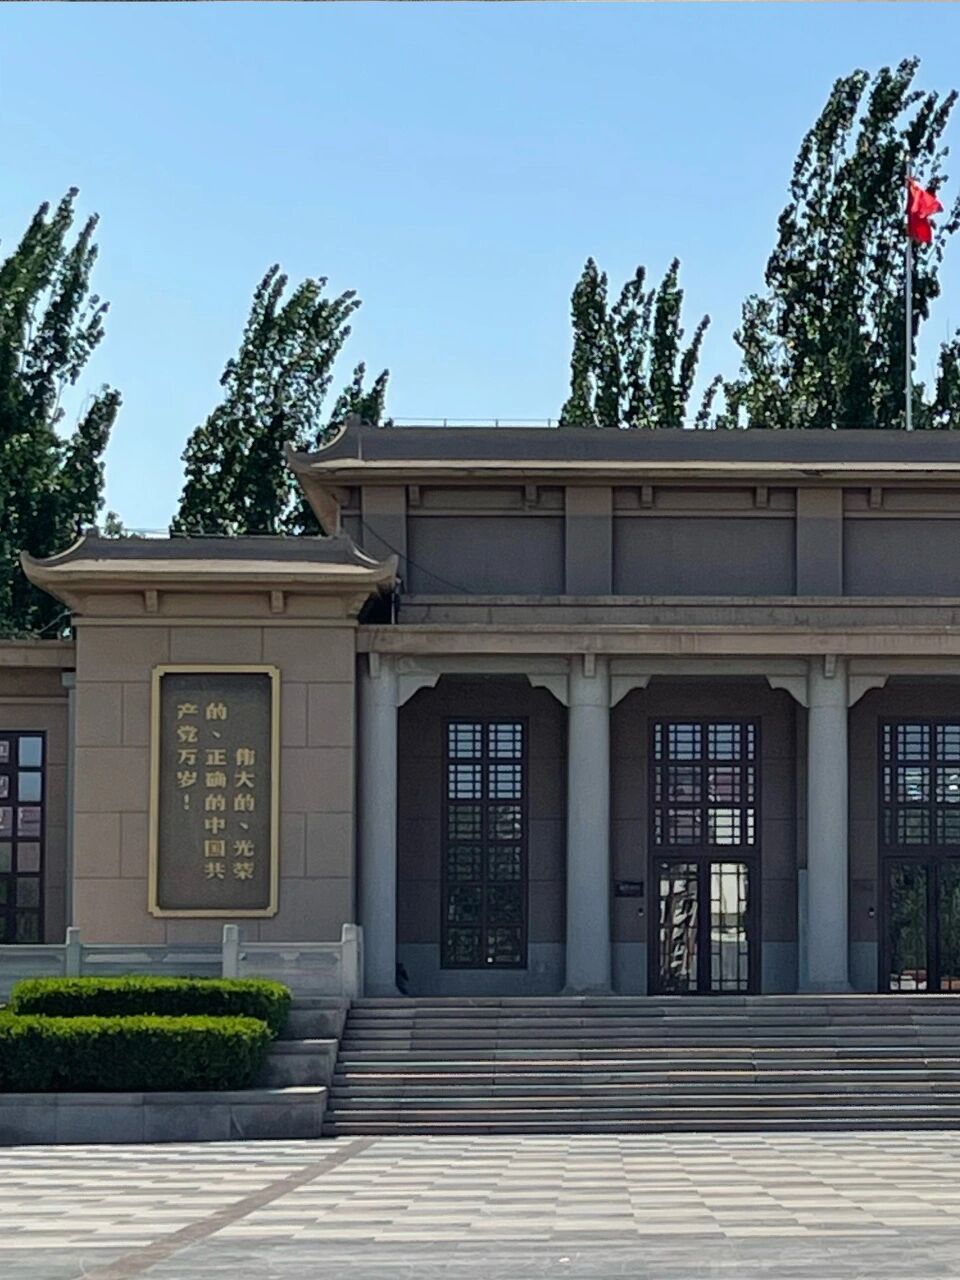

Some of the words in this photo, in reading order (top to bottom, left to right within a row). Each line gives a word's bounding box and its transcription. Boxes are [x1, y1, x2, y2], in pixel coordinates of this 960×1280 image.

[176, 702, 199, 810] 产党万岁!
[204, 702, 228, 880] 的、正确的中国共
[233, 747, 256, 880] 伟大的、光荣
